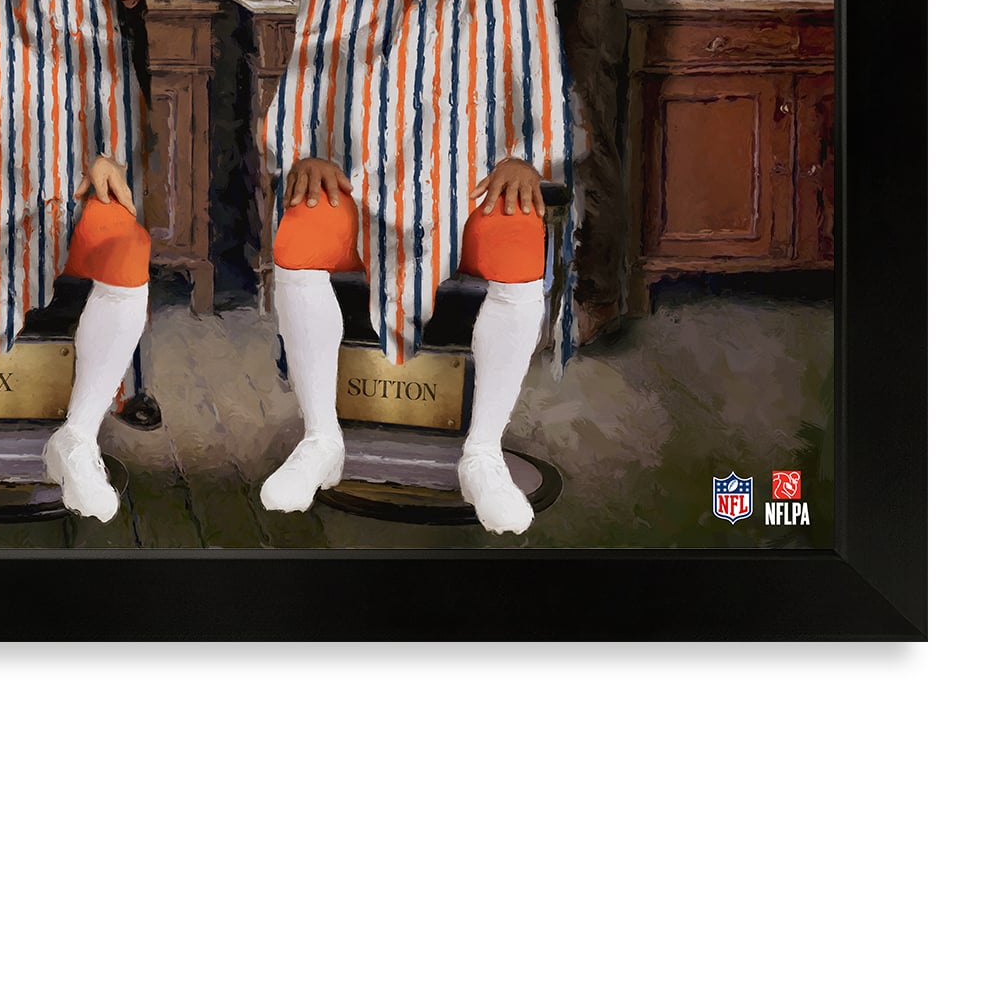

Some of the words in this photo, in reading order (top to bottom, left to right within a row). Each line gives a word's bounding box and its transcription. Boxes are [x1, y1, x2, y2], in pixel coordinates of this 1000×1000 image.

[347, 378, 438, 401] SUTTON
[717, 494, 749, 517] NFL
[764, 502, 811, 526] NFLPA
